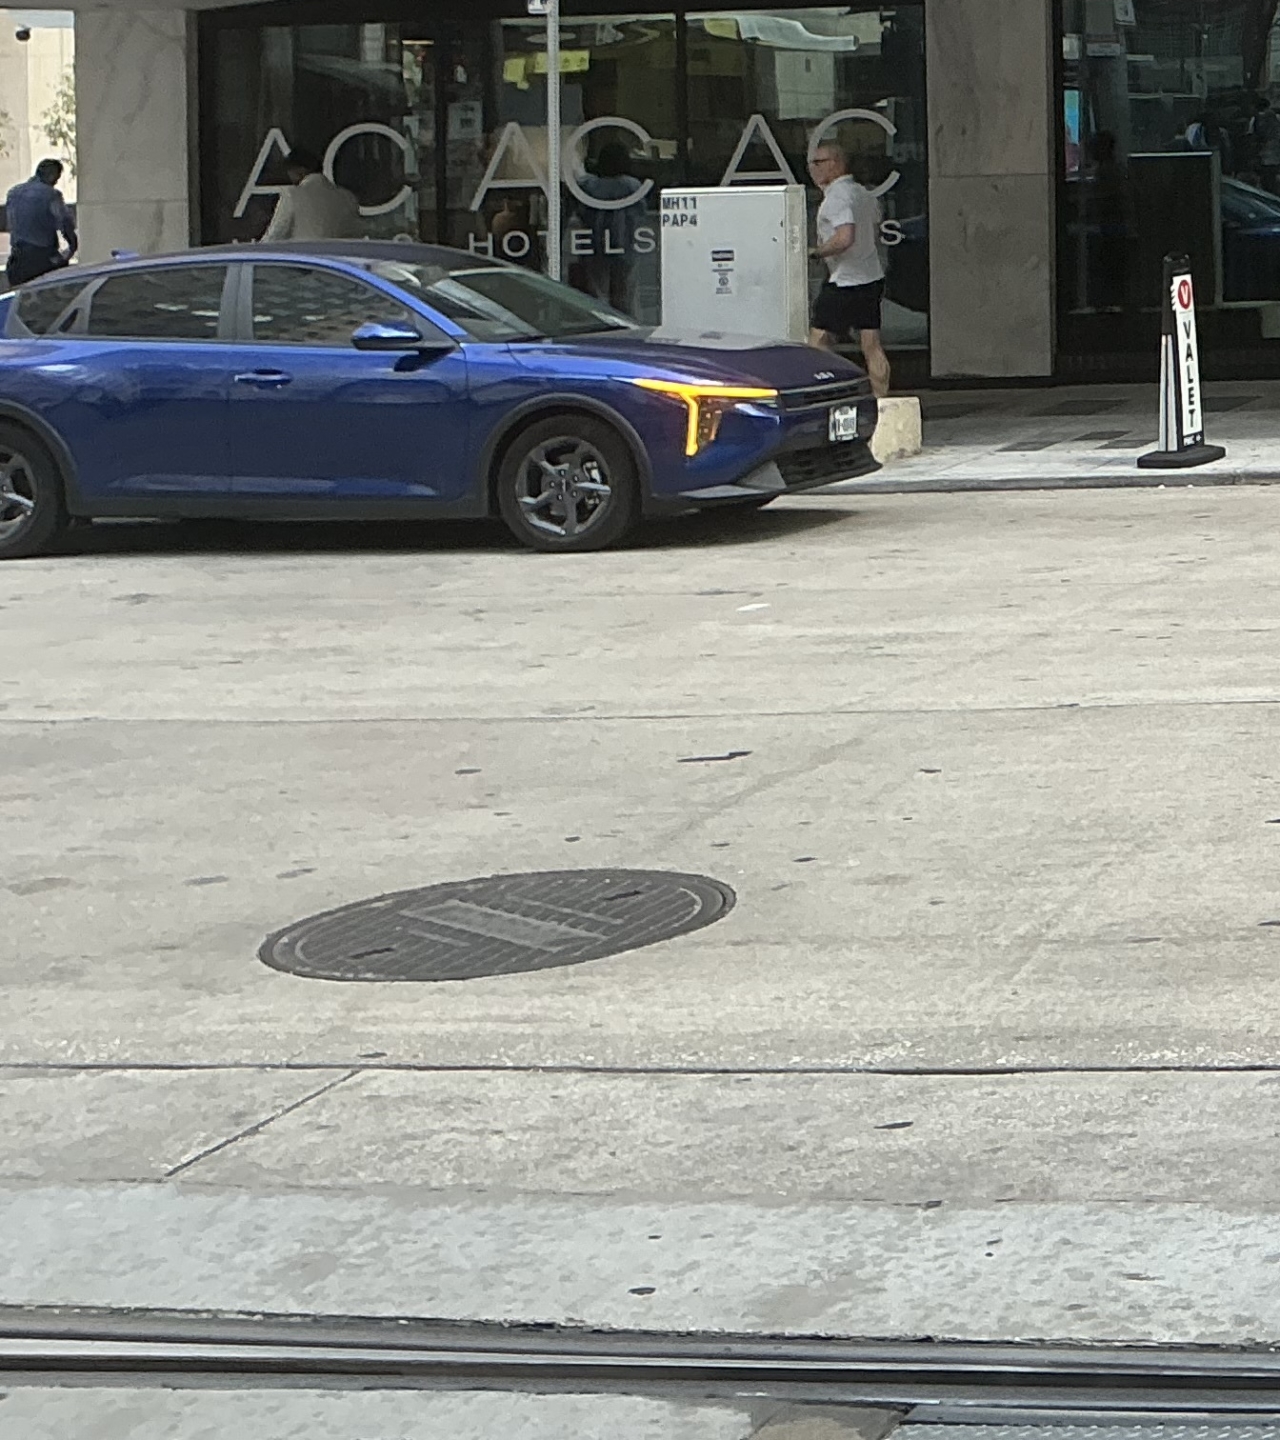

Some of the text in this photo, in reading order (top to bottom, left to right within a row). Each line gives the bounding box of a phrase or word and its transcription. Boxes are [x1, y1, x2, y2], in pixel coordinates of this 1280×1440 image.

[468, 116, 655, 212] AC
[661, 196, 698, 210] MH11
[661, 213, 698, 227] PAP4
[1183, 320, 1196, 428] VALET
